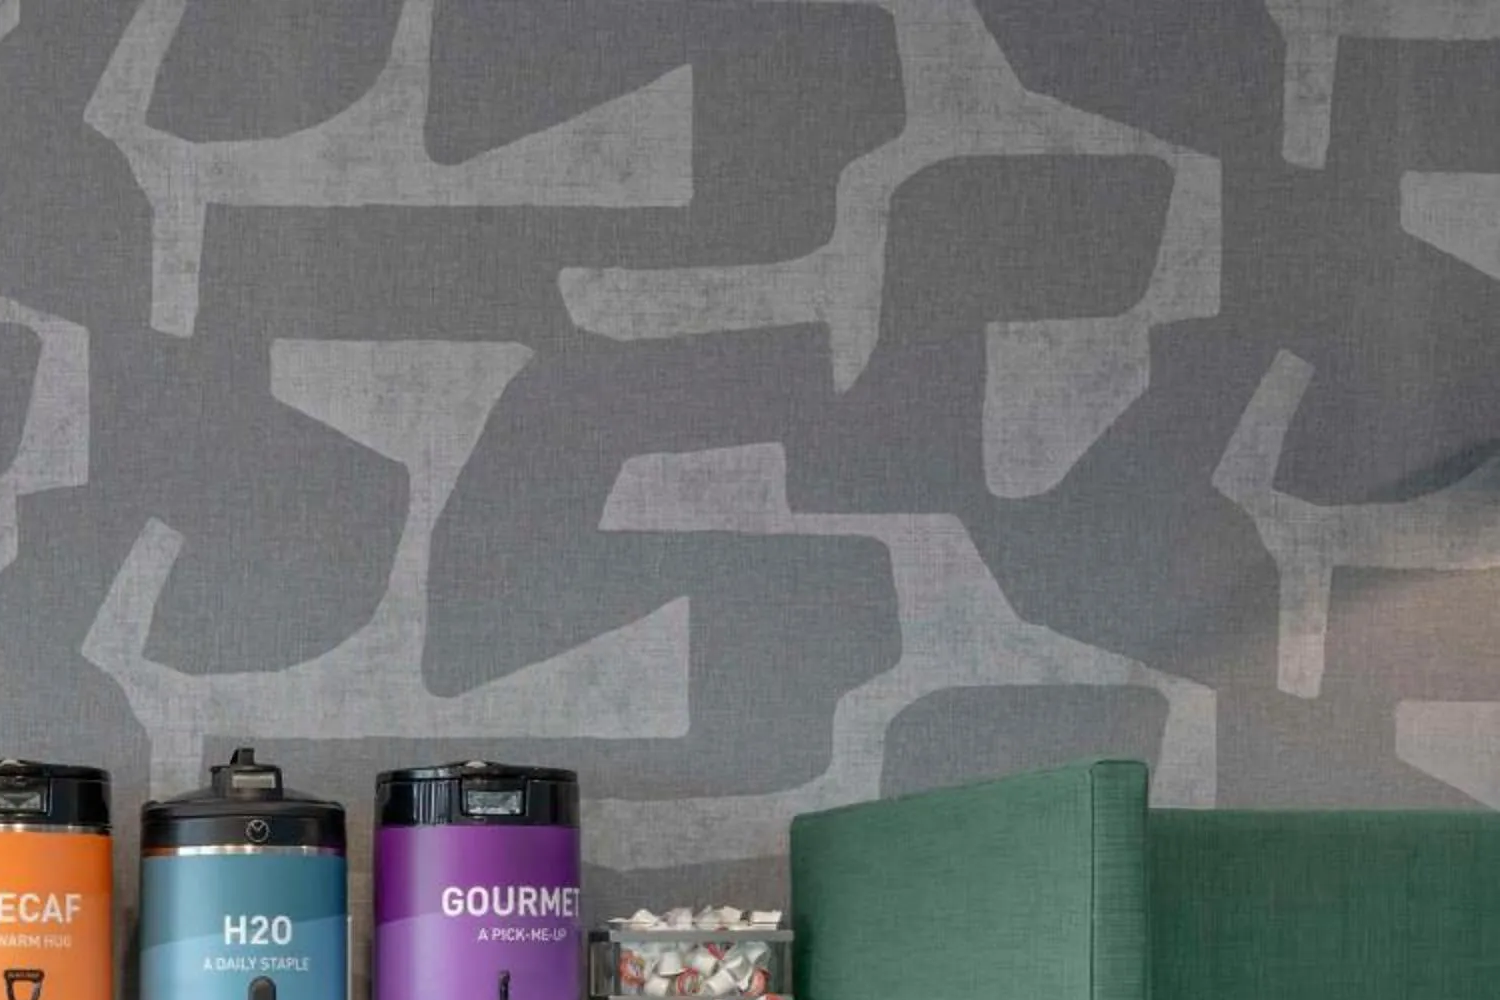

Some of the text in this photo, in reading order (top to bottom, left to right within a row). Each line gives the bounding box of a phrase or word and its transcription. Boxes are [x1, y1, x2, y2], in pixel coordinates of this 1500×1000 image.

[478, 927, 489, 941] A
[203, 957, 310, 971] A DAILY STAPLE
